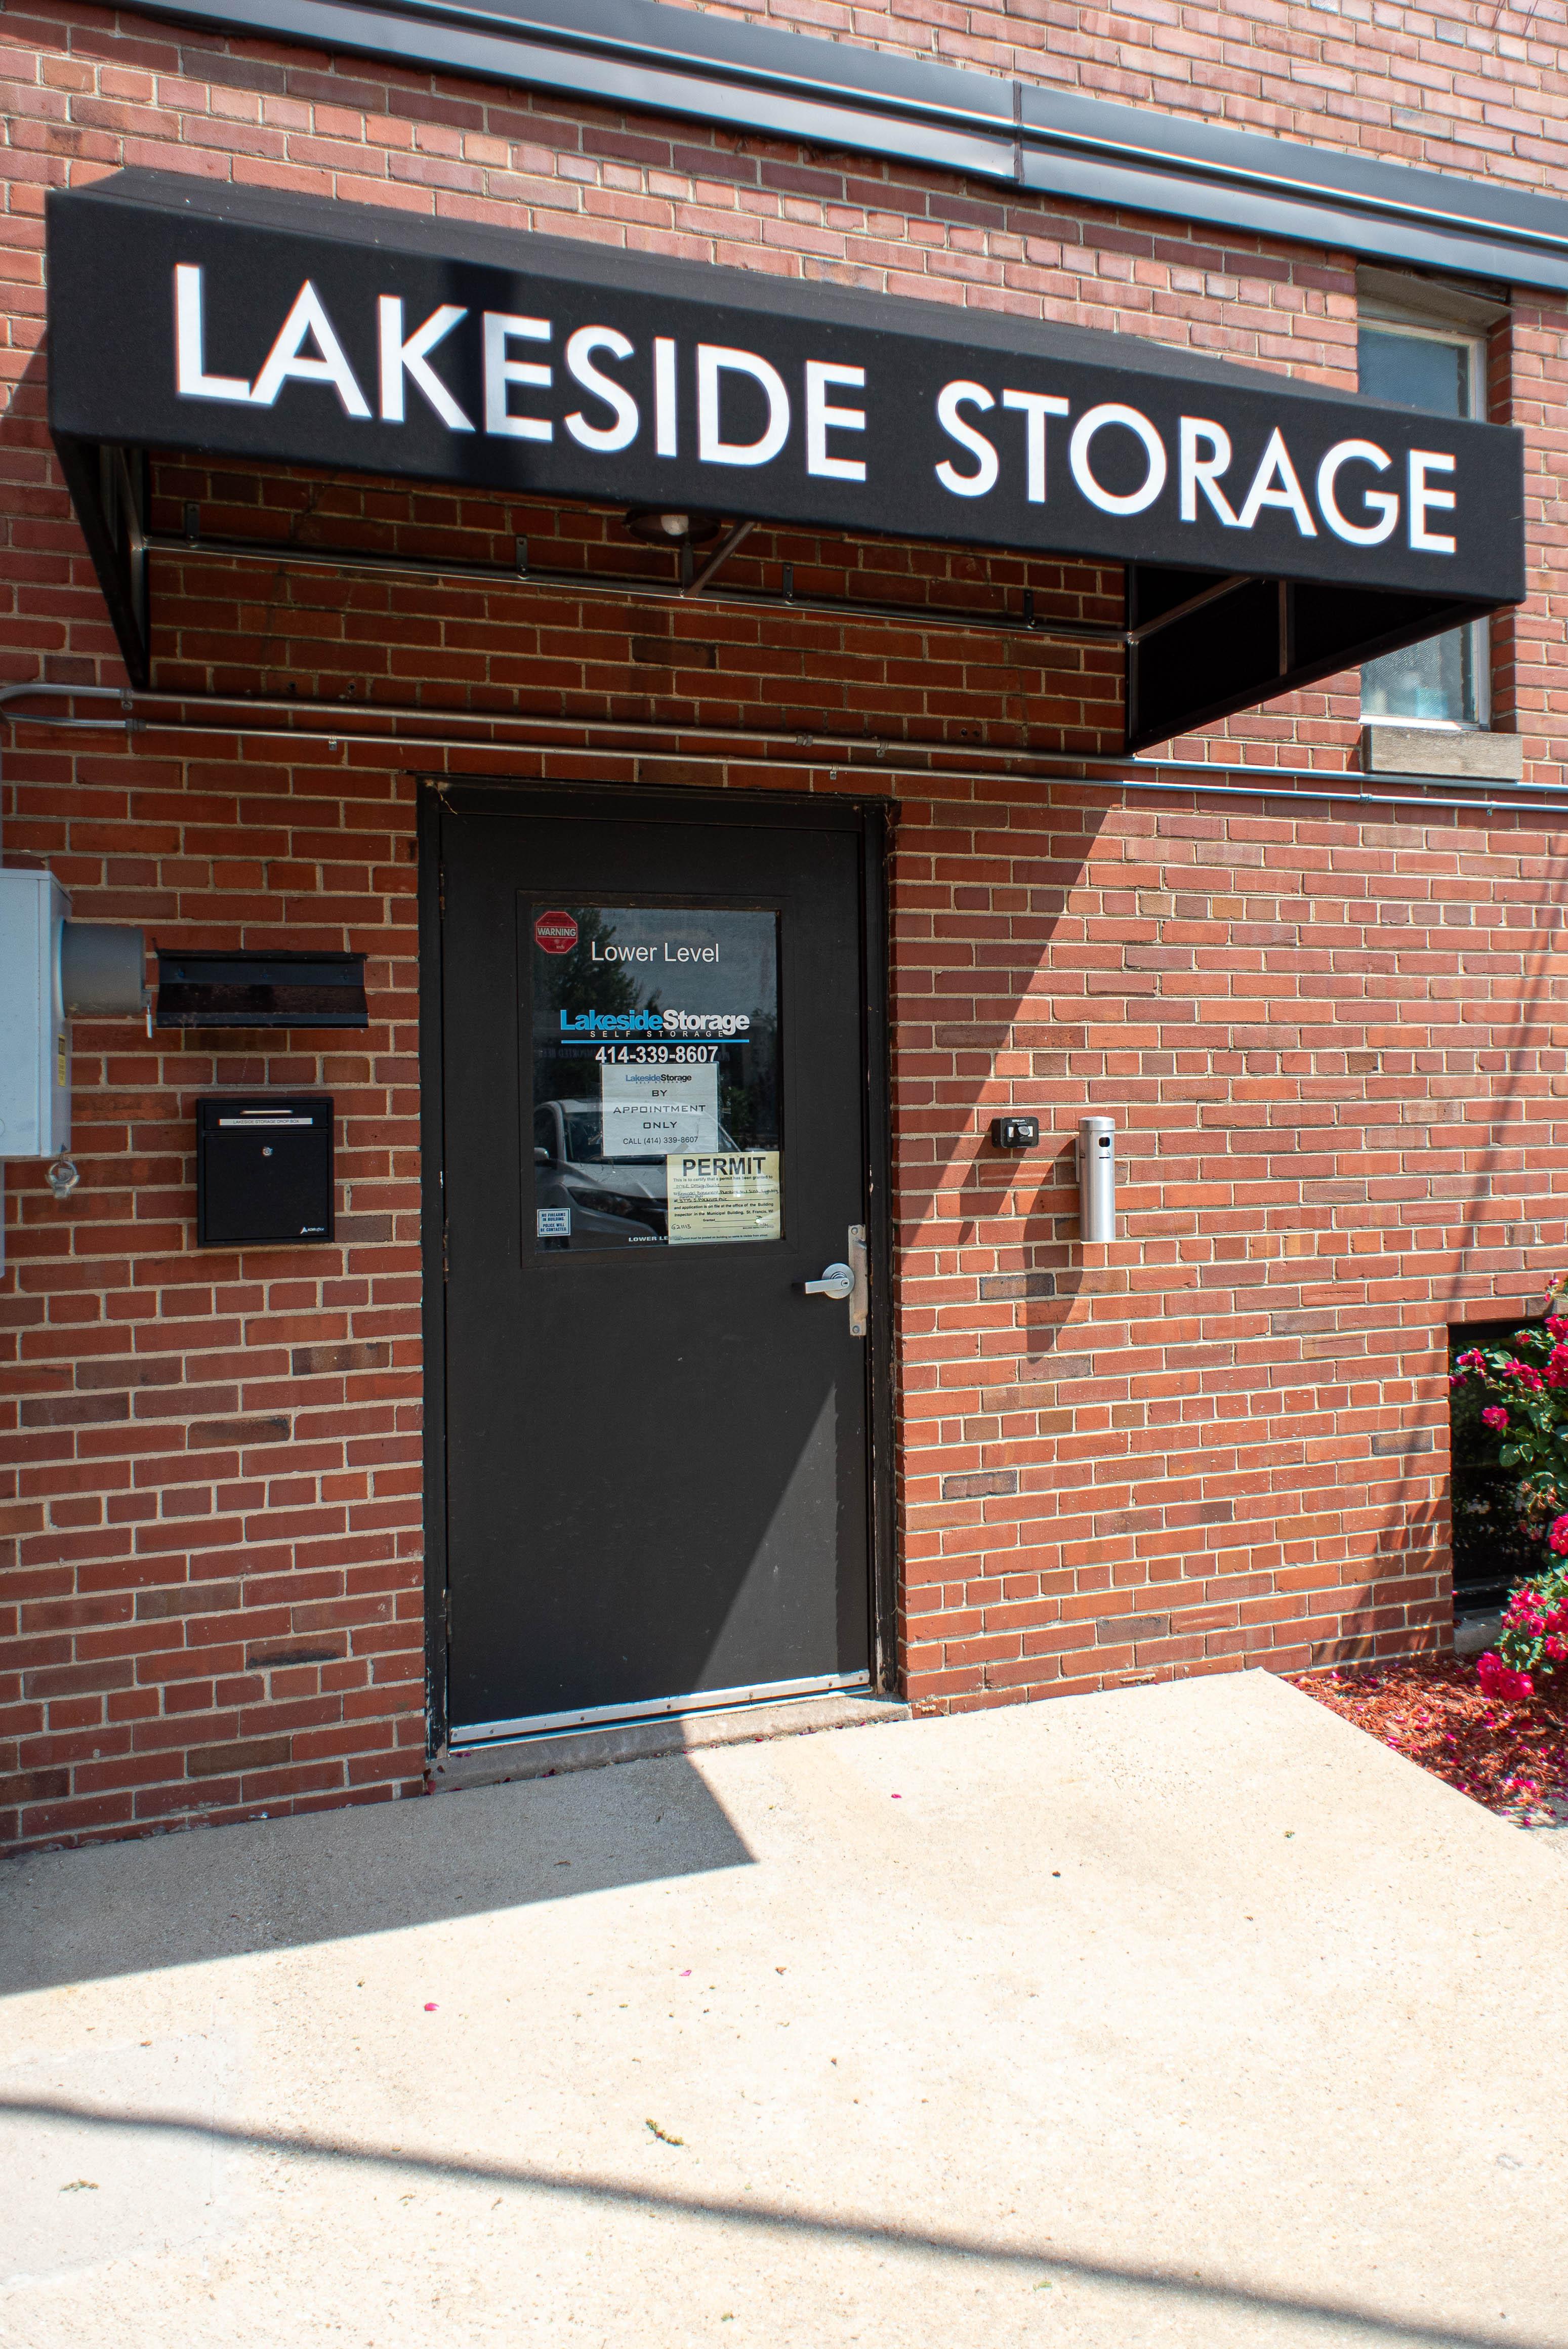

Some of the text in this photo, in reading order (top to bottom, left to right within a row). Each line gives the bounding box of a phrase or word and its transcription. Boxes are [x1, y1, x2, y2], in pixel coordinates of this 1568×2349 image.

[174, 263, 1458, 554] LAKESIDE STORAGE
[538, 928, 576, 936] WARNING
[592, 941, 719, 962] Lower Level
[560, 1010, 750, 1035] LakesideStorage
[595, 1046, 718, 1063] 414-339-8607
[626, 1074, 692, 1082] LakesideStorage
[613, 1105, 706, 1114] APPOINTMENT
[683, 1157, 766, 1176] PERMIT
